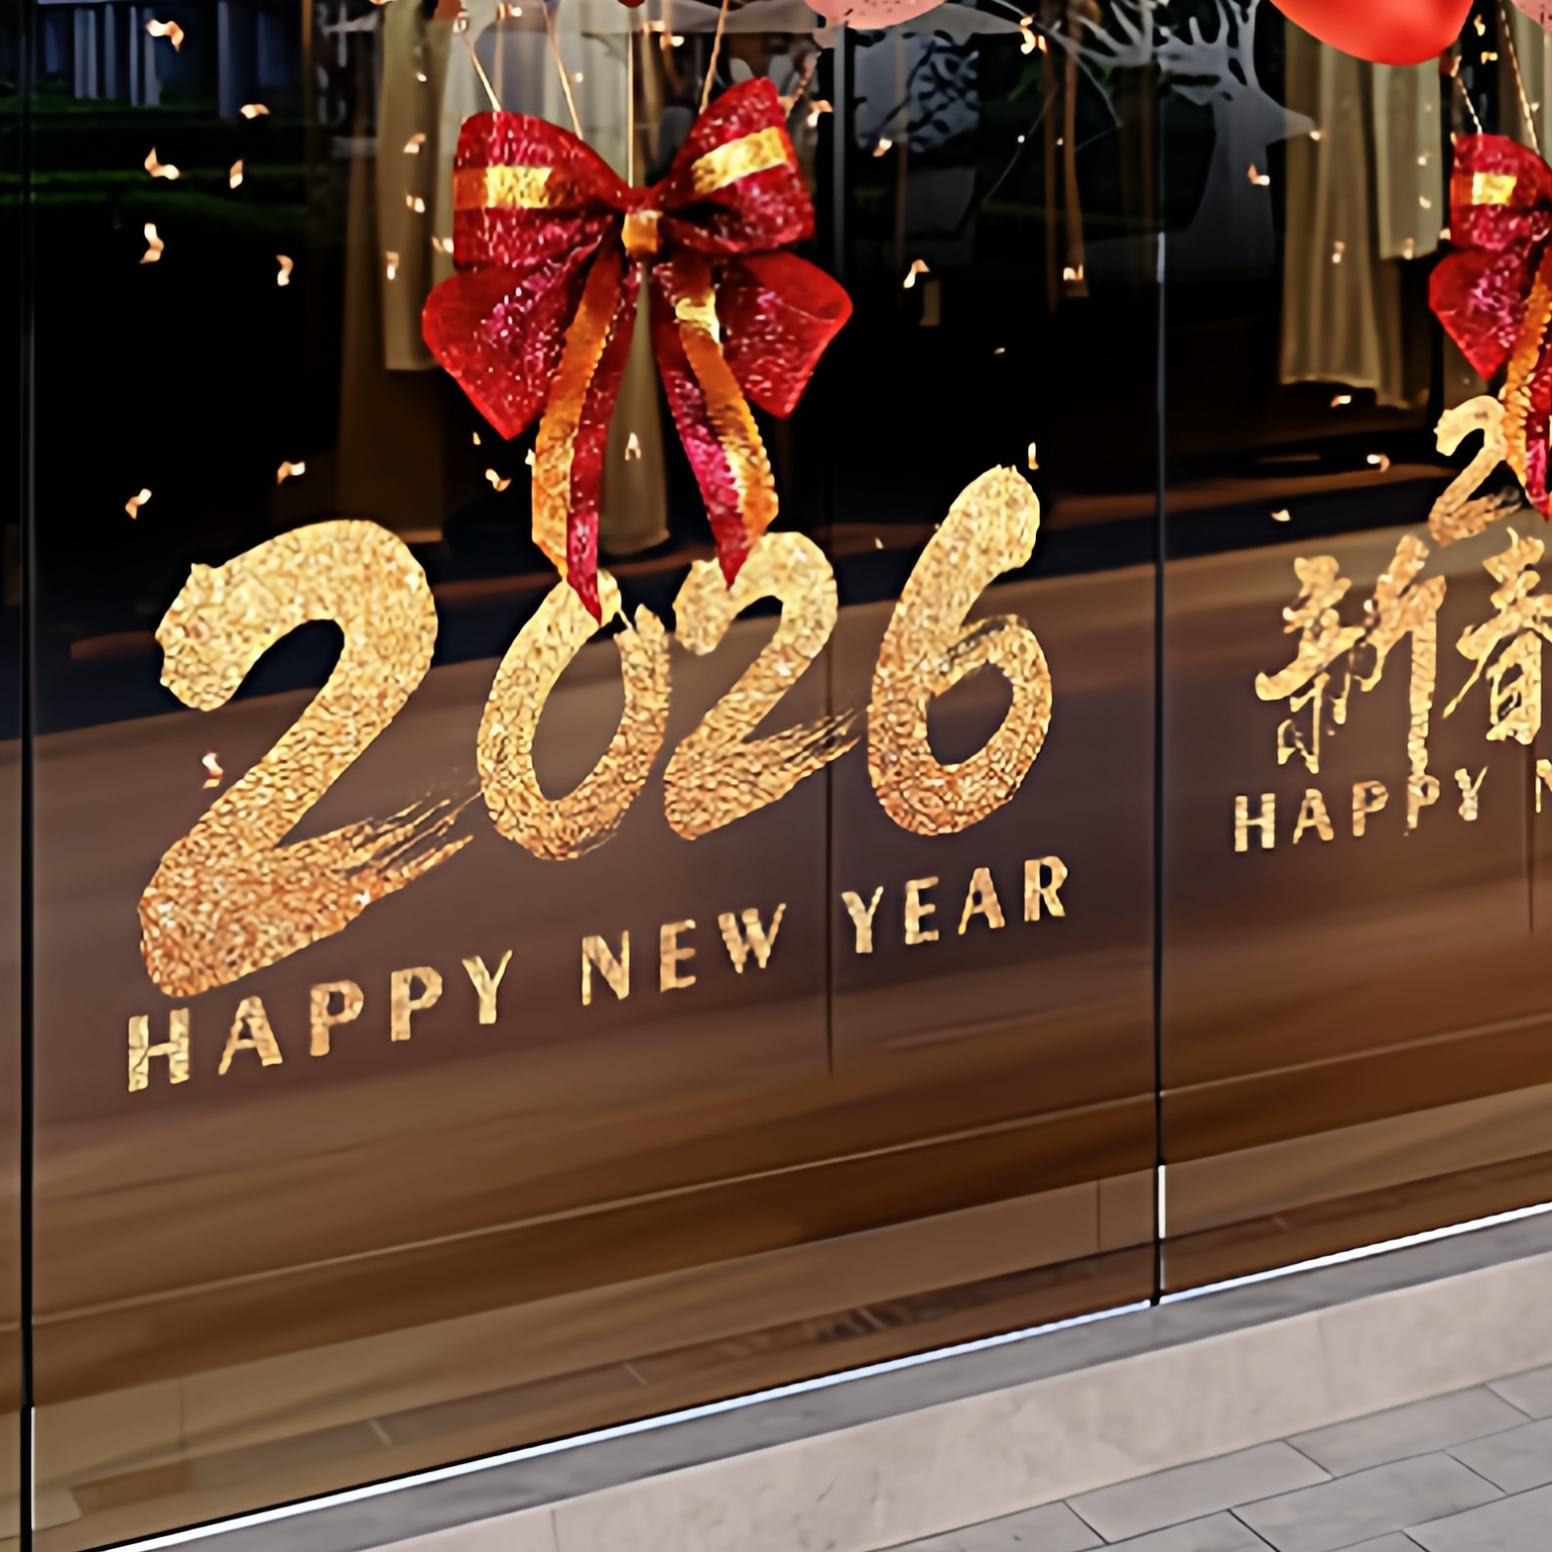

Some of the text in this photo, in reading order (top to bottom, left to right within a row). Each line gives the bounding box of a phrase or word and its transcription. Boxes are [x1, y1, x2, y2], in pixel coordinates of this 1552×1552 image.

[138, 464, 1053, 996] 2026
[1234, 765, 1489, 853] HAPPY
[127, 854, 1070, 1093] HAPPY NEW YEAR
